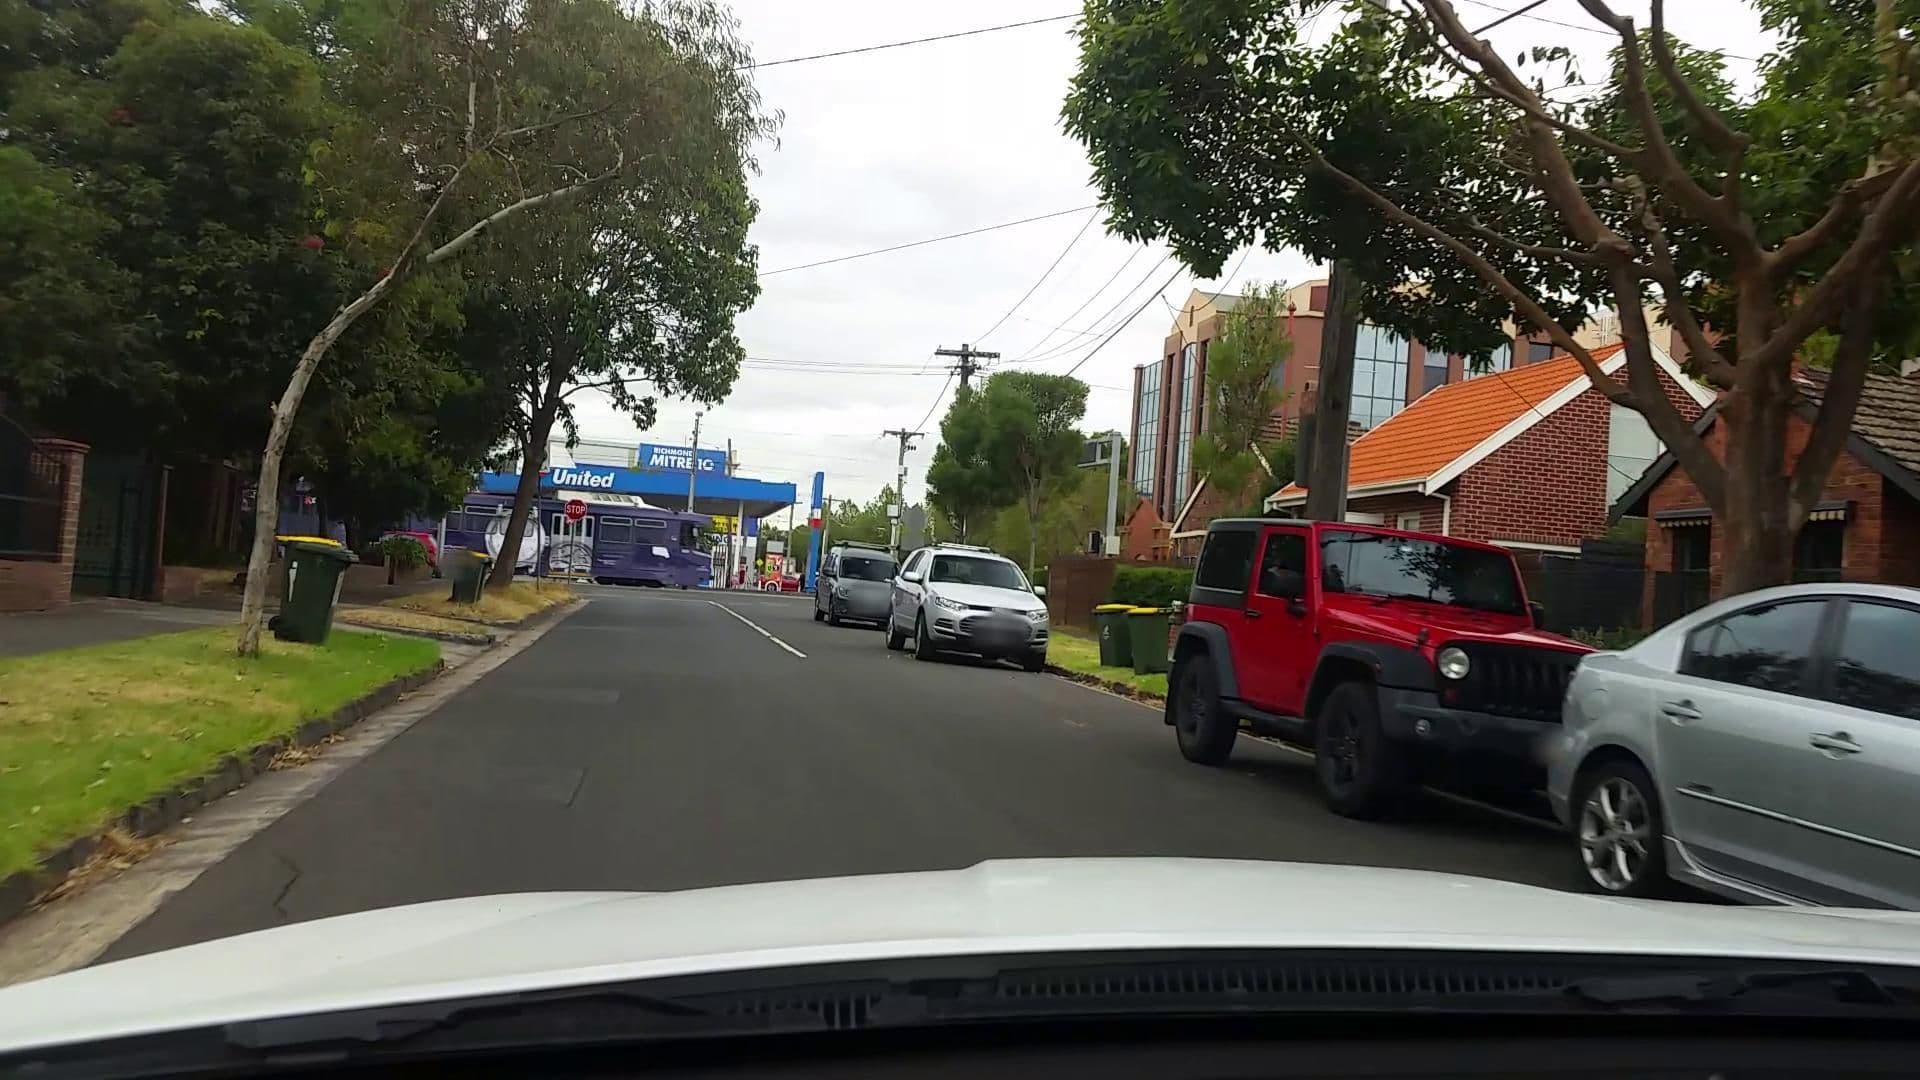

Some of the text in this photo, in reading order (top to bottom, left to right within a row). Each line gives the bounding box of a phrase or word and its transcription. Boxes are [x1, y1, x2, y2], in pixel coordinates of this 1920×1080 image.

[649, 454, 693, 470] MITRE
[552, 468, 615, 488] United
[566, 504, 586, 514] STOP
